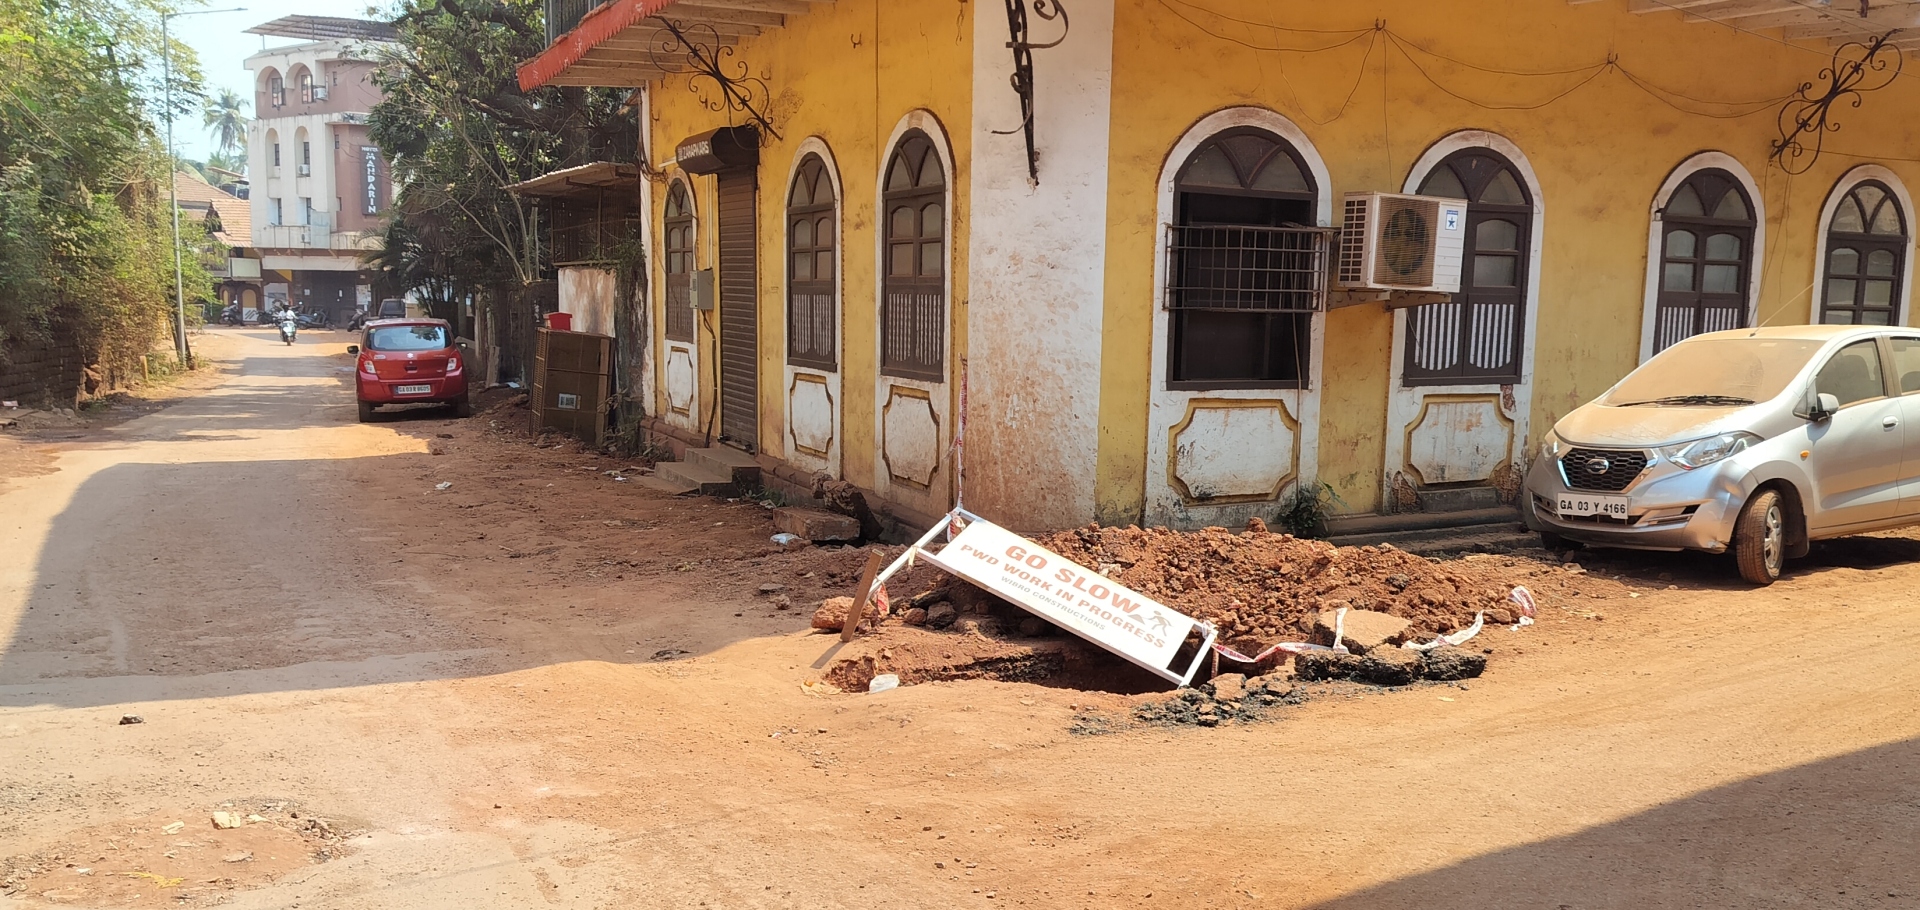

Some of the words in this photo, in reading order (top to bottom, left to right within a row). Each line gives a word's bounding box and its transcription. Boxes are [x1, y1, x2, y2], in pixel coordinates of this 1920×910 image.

[366, 152, 376, 213] MANDARIN
[1560, 500, 1573, 510] GA
[1577, 501, 1589, 511] 03
[1593, 502, 1600, 513] Y
[1603, 503, 1626, 514] 4166
[960, 544, 999, 565] PWD
[1003, 563, 1052, 591] WORK
[1055, 588, 1075, 602] IN
[1078, 599, 1166, 649] PROGRESS
[1001, 575, 1031, 594] WIBRO
[1032, 591, 1106, 631] CONSTRUCTIONS
[1005, 545, 1047, 570] GO
[1054, 567, 1142, 614] SLOW
